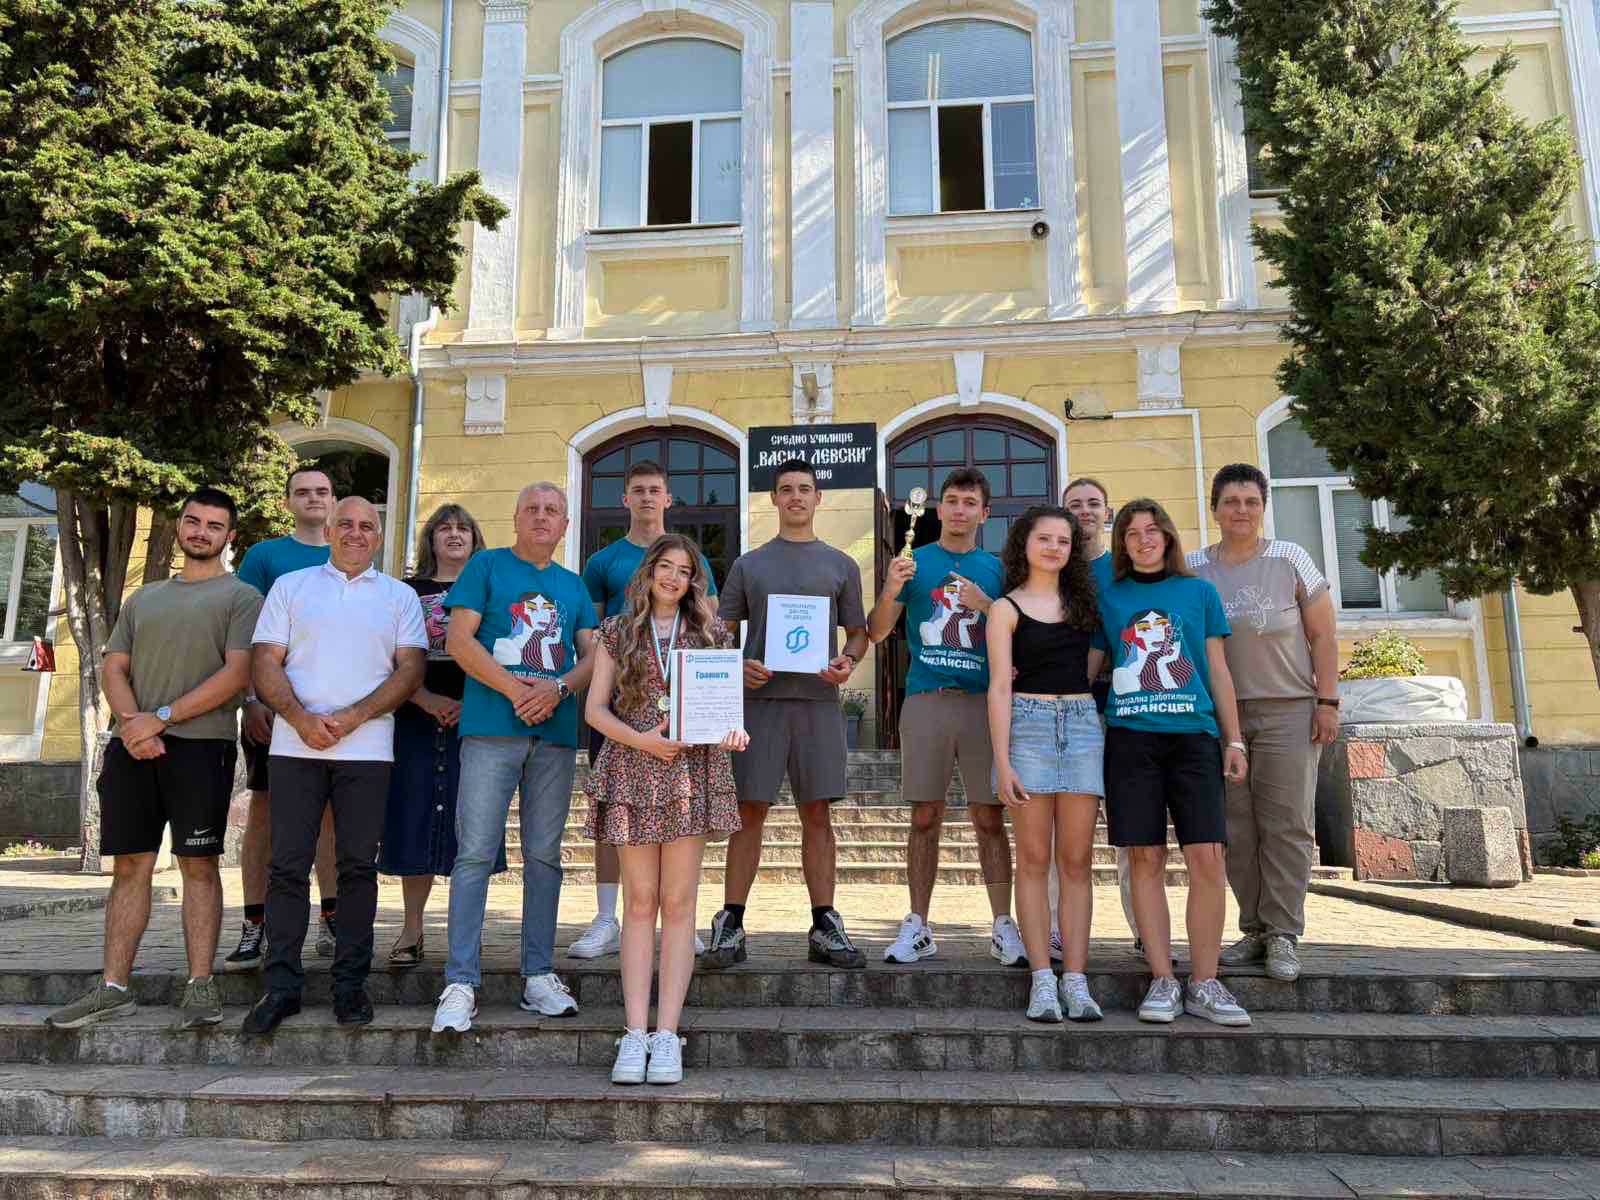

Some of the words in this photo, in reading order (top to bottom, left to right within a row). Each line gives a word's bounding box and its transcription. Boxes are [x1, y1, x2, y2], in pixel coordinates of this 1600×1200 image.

[770, 434, 807, 446] СРЕДНО
[809, 432, 853, 444] УЧИЛИЩЕ
[1116, 702, 1194, 716] МИЗАНСЦЕН
